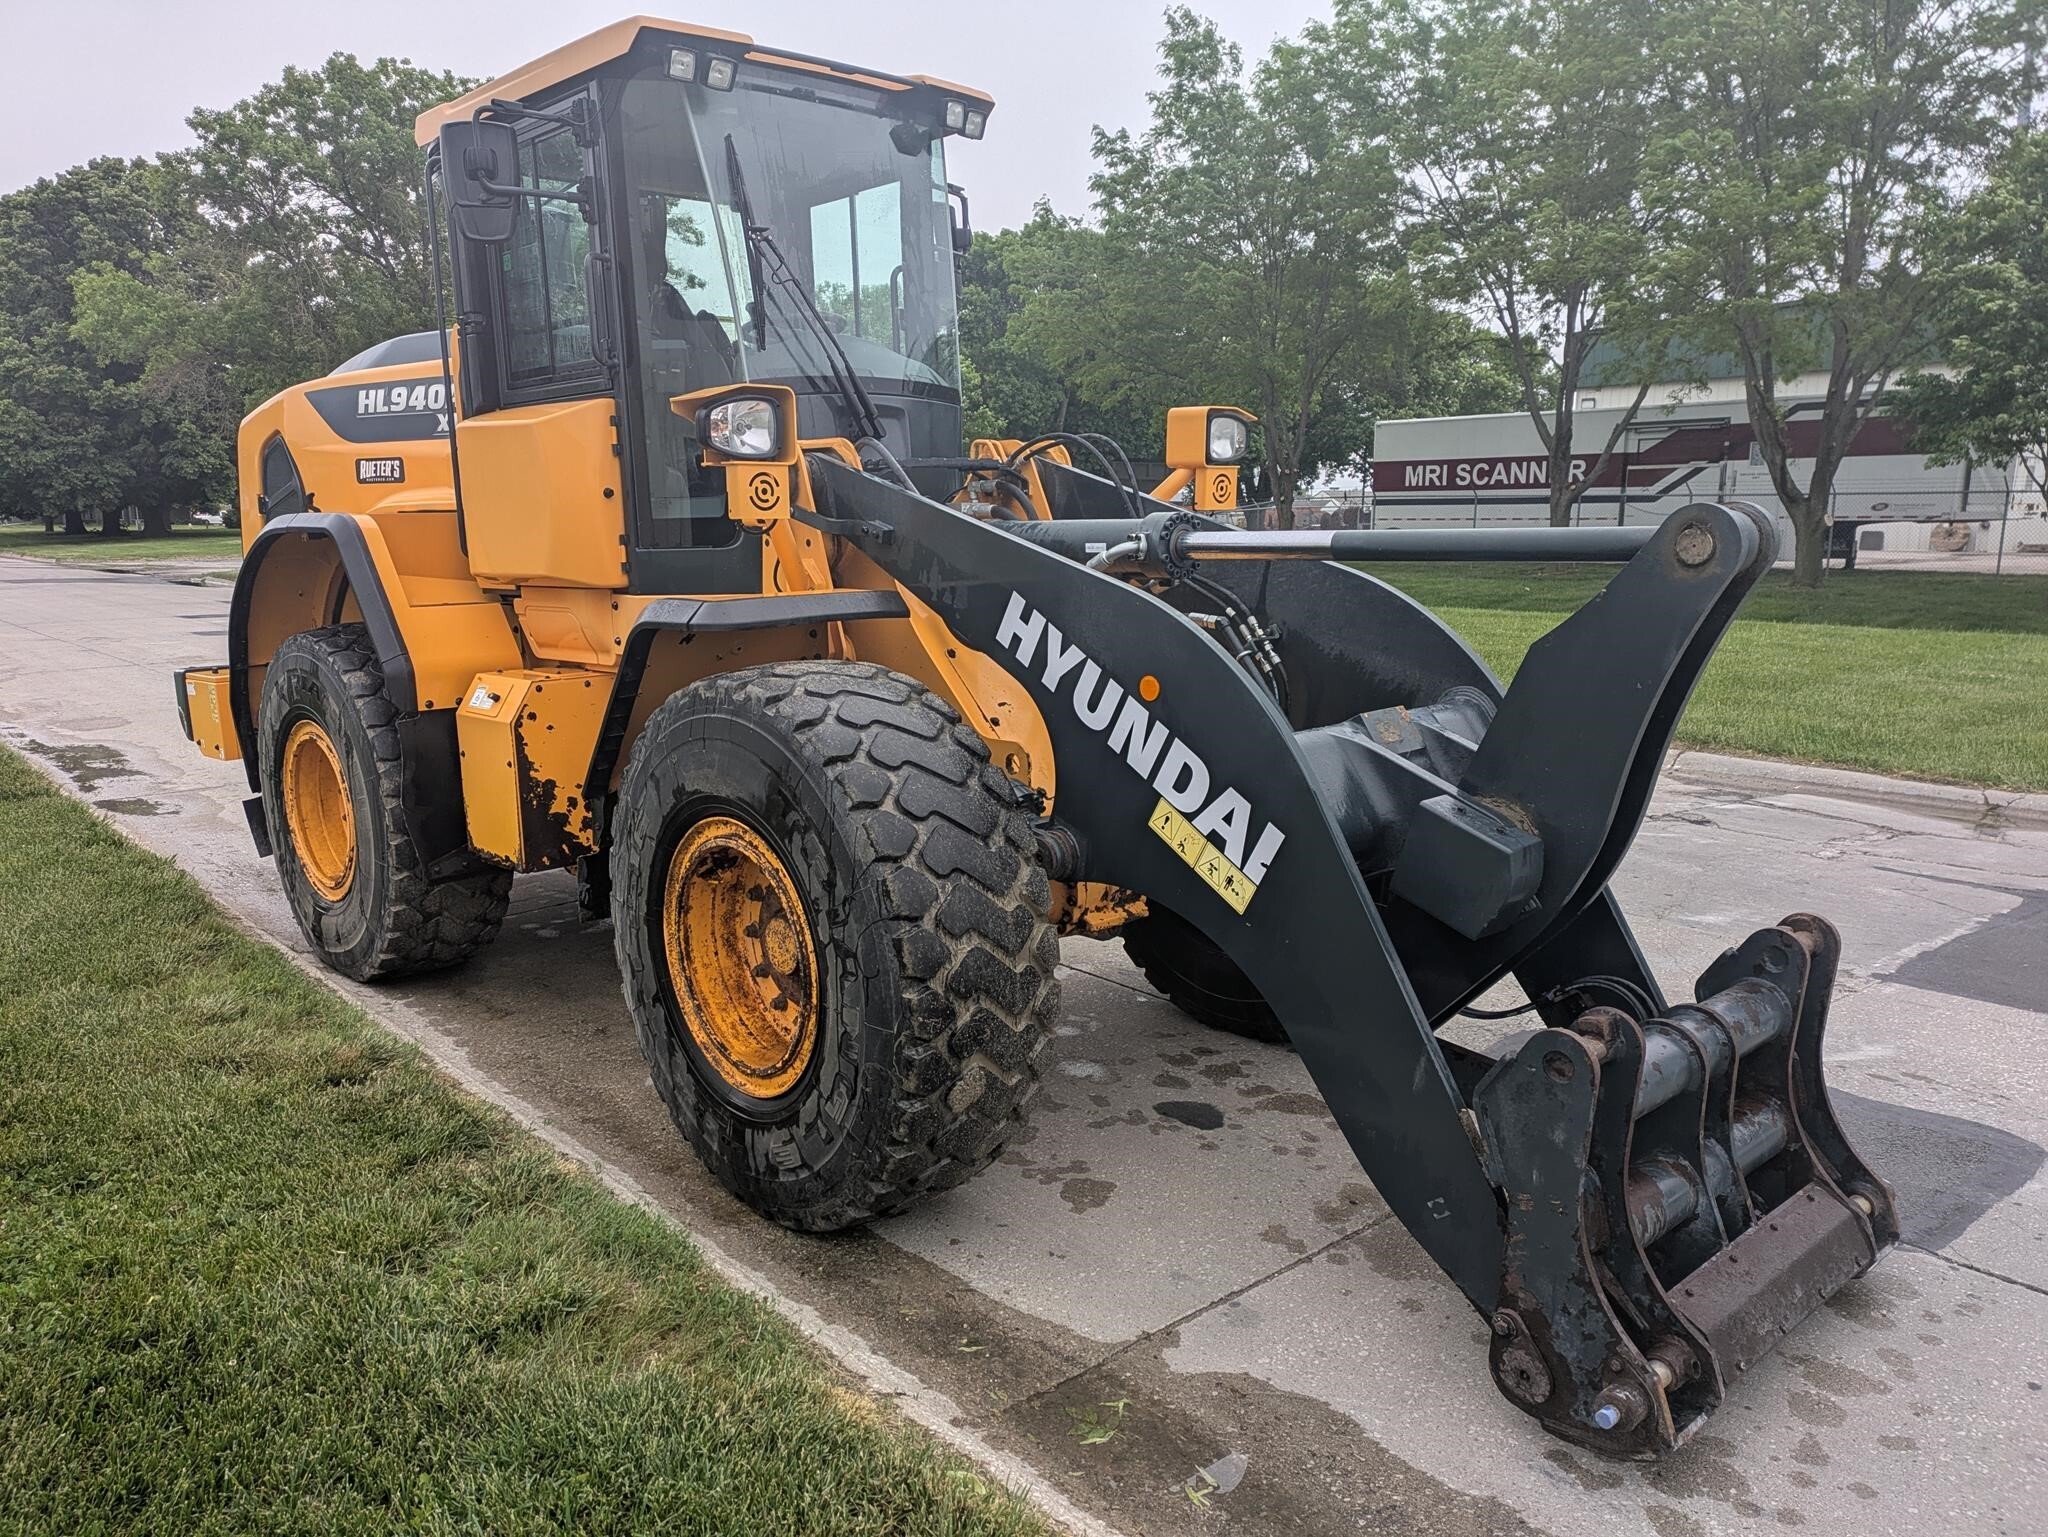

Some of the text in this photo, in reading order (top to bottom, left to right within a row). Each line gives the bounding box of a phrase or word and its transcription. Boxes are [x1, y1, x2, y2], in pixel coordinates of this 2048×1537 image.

[357, 383, 456, 414] HL940
[359, 460, 400, 480] RUETER'S
[1404, 459, 1587, 487] MRI SCANNR
[995, 590, 1286, 885] HYUNDAI
